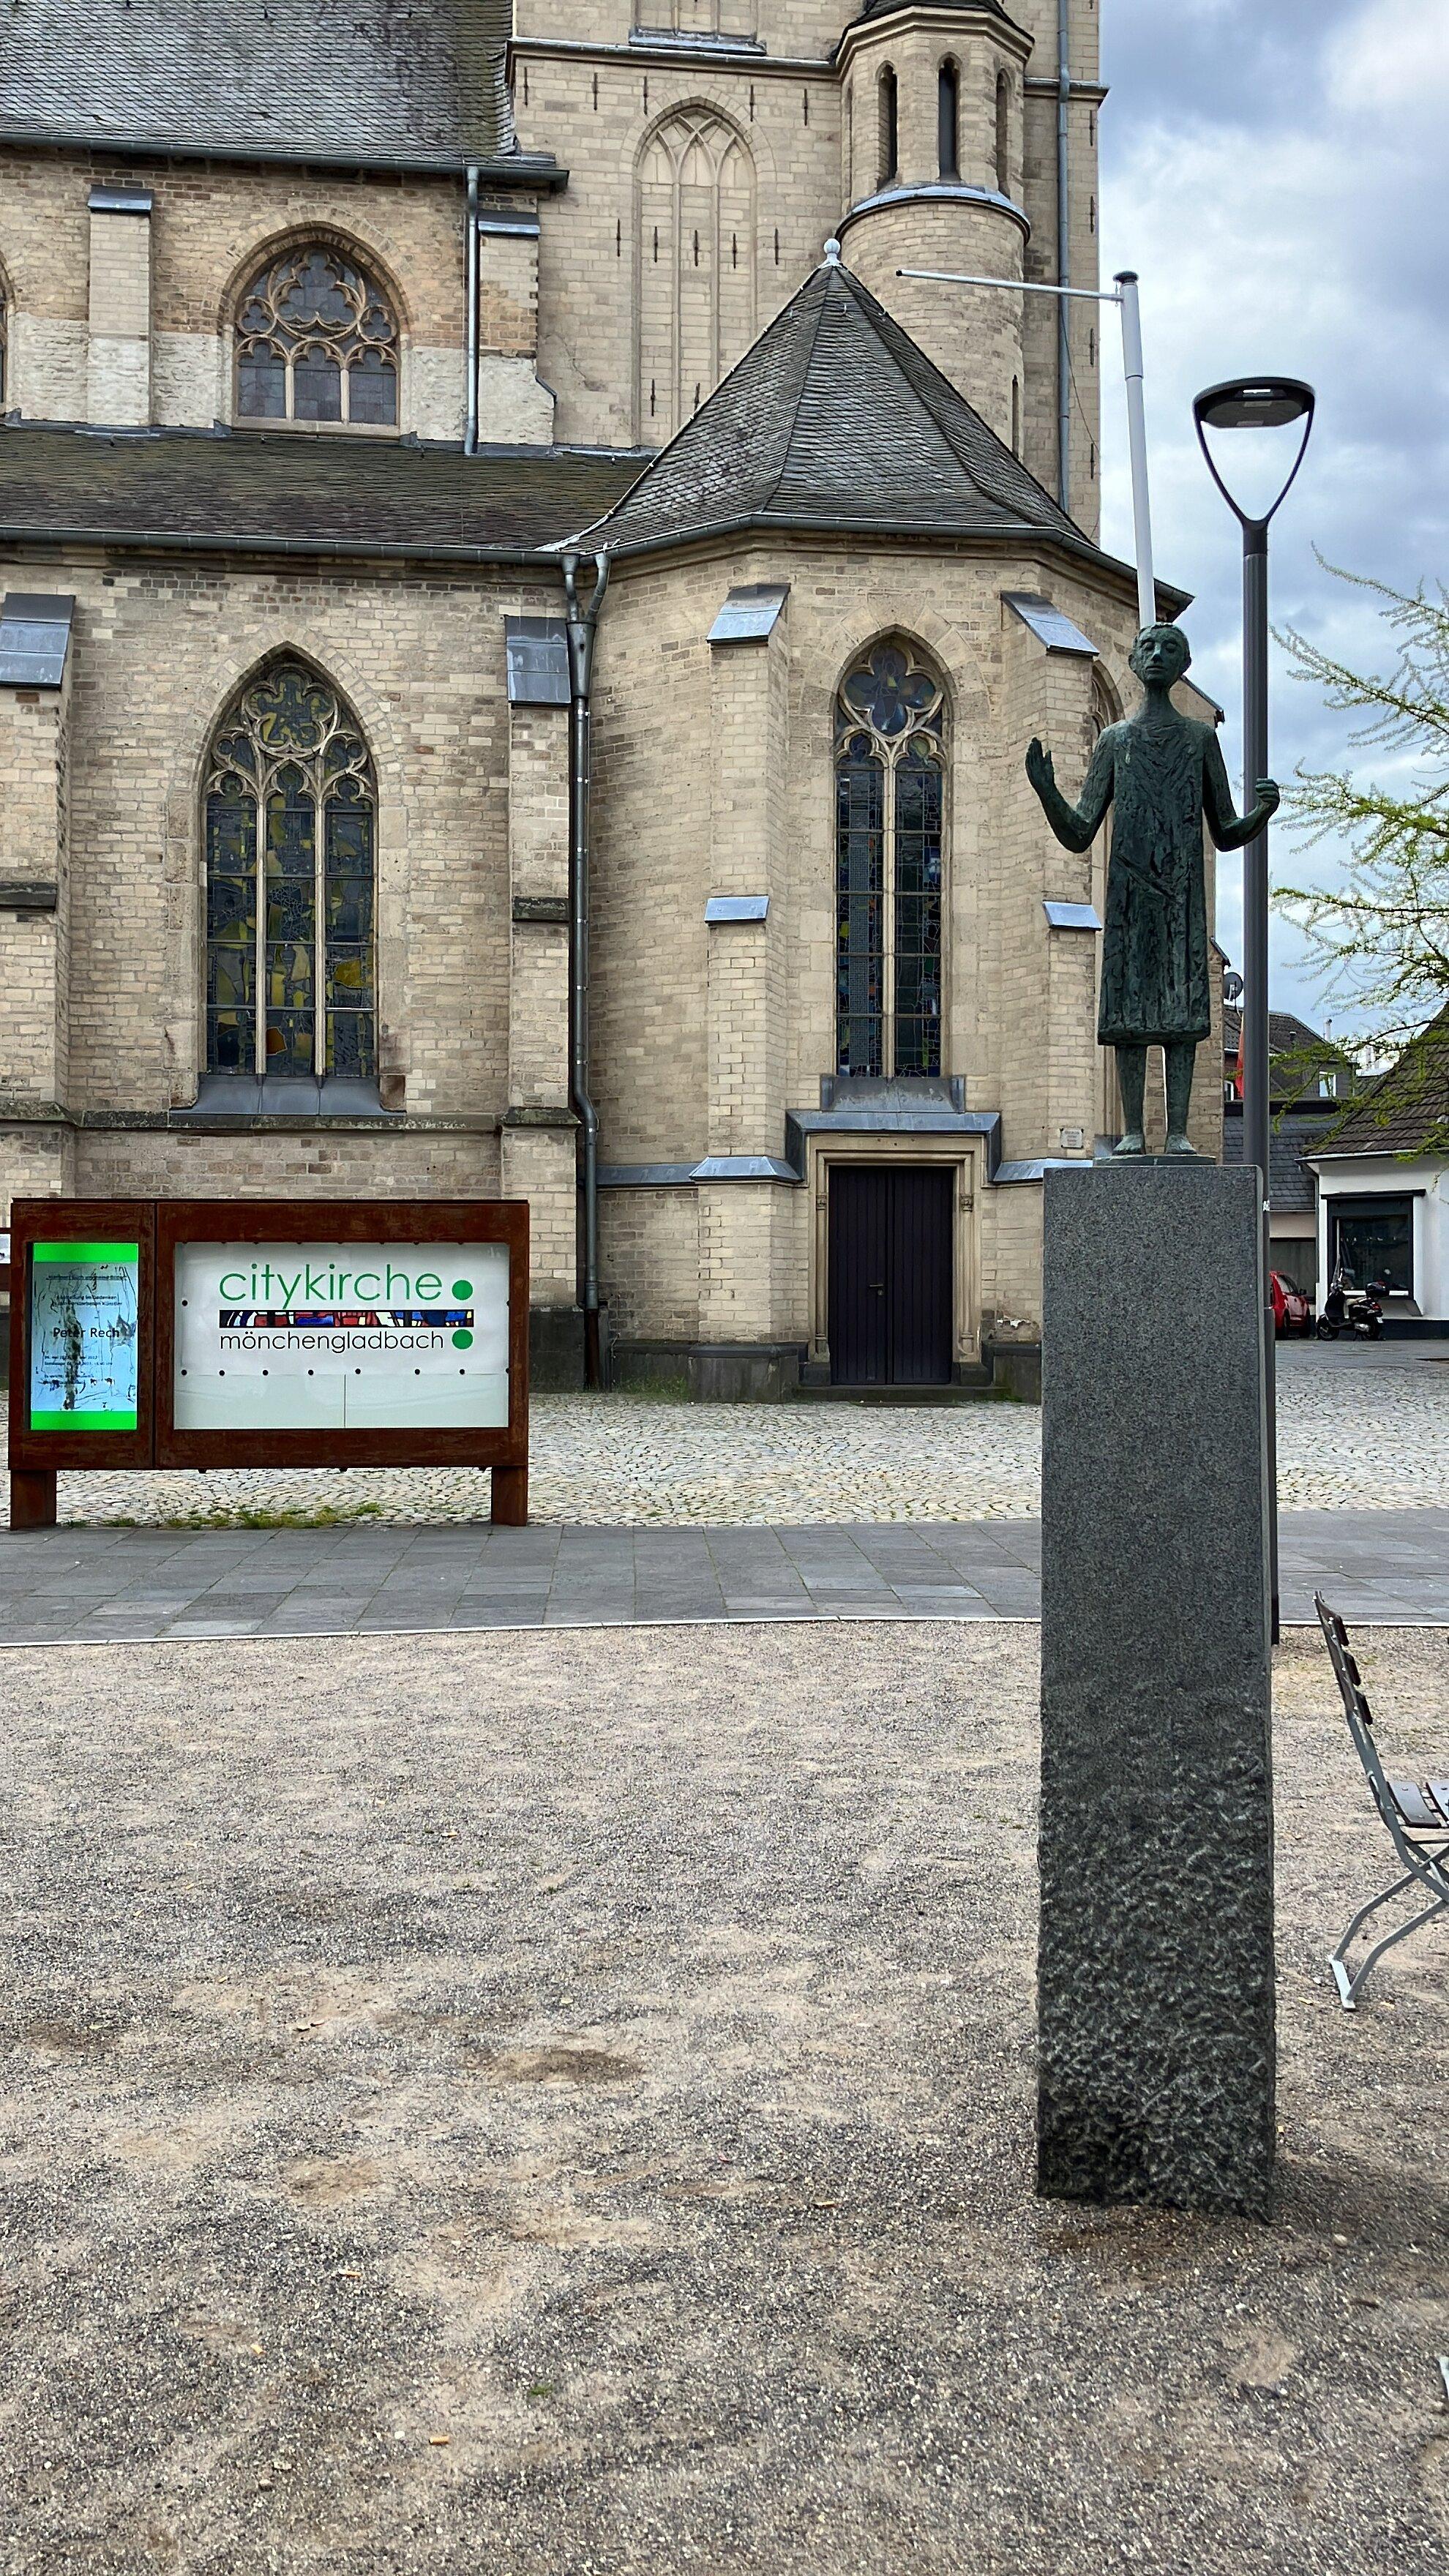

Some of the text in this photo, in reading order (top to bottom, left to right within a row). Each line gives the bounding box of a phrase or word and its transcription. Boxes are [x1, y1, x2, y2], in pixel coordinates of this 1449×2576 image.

[220, 1263, 443, 1309] citykirche
[53, 1327, 120, 1338] Peter Rech
[220, 1330, 443, 1353] mönchengladbach
